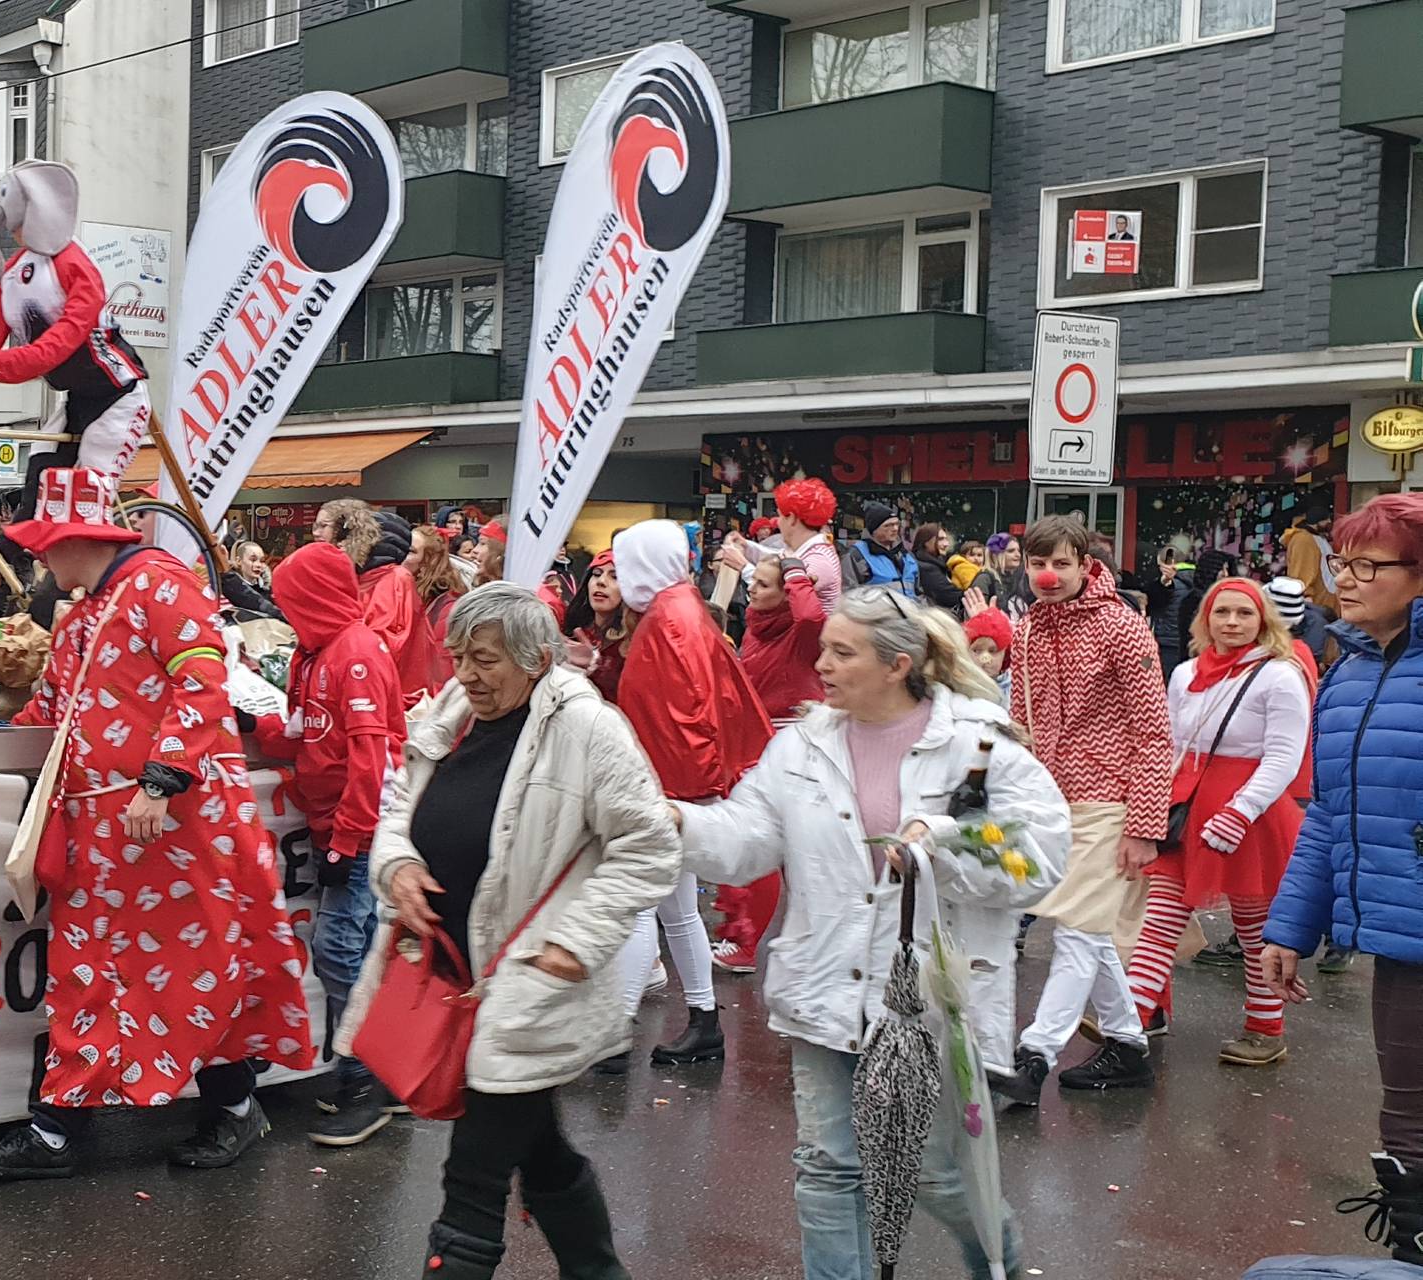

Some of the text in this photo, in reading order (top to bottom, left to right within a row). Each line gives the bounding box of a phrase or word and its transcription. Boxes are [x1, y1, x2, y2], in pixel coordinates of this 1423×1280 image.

[106, 299, 166, 323] arthaus
[183, 243, 271, 370] Radsportverein
[543, 212, 619, 353] Radsportverein
[1061, 320, 1100, 334] Durchfahrt
[175, 277, 337, 510] üttringhausen
[177, 259, 302, 467] ADLER
[535, 232, 640, 470] ADLER
[1063, 349, 1095, 359] gesperrt
[522, 256, 670, 540] Lüttringhausen
[622, 437, 634, 447] 75
[1372, 420, 1423, 438] Bitburge
[831, 425, 1276, 484] SPIELLLE
